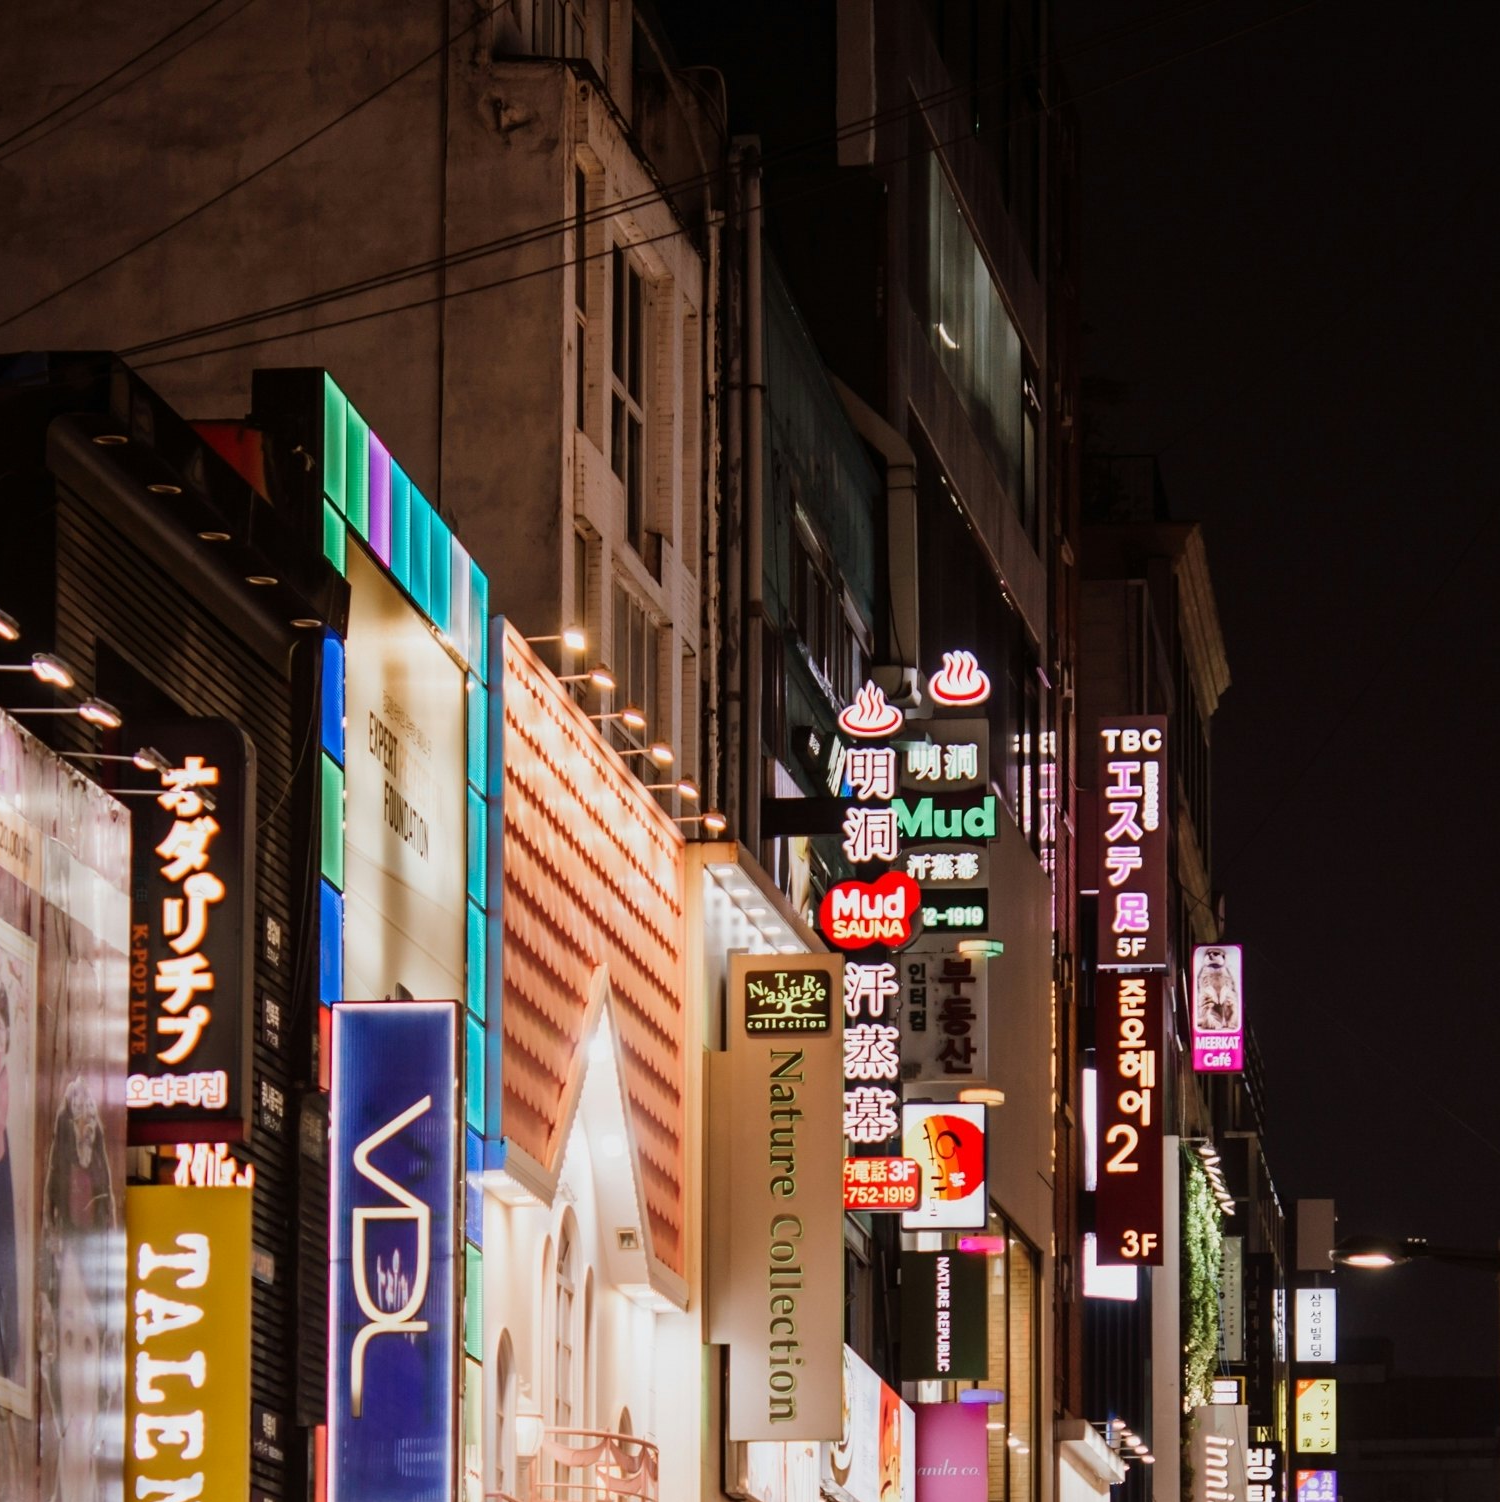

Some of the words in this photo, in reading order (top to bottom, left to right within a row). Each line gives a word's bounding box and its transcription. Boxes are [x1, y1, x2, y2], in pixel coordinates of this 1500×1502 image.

[1101, 729, 1162, 752] TBC
[908, 743, 979, 781] 明洞
[384, 780, 430, 864] FOUNDATION
[843, 747, 898, 864] 明洞
[893, 796, 996, 838] Mud
[1104, 760, 1143, 886] エステ
[907, 853, 980, 880] 汗蒸幕
[831, 887, 905, 921] Mud
[1113, 892, 1149, 931] 足
[832, 918, 905, 939] SAUNA
[1117, 938, 1147, 957] 5F
[747, 1018, 827, 1029] collection
[937, 958, 978, 1076] 부동산
[843, 960, 899, 1142] 汗蒸幕
[1116, 979, 1156, 1127] 준오헤어
[1195, 1036, 1240, 1051] MEERKAT
[1202, 1051, 1233, 1069] Café
[126, 1070, 228, 1109] 오다리집
[768, 1047, 805, 1199] Nature
[1106, 1125, 1139, 1174] 2
[889, 1160, 916, 1182] 3F
[843, 1185, 916, 1206] -752-1919
[1121, 1231, 1157, 1257] 3F
[937, 1256, 950, 1308] NATURE
[768, 1212, 805, 1425] Collection
[1310, 1293, 1323, 1358] 삼성빌딩
[937, 1311, 950, 1373] REPUBLIC
[1320, 1382, 1331, 1449] マッサージ
[917, 1459, 958, 1476] anila
